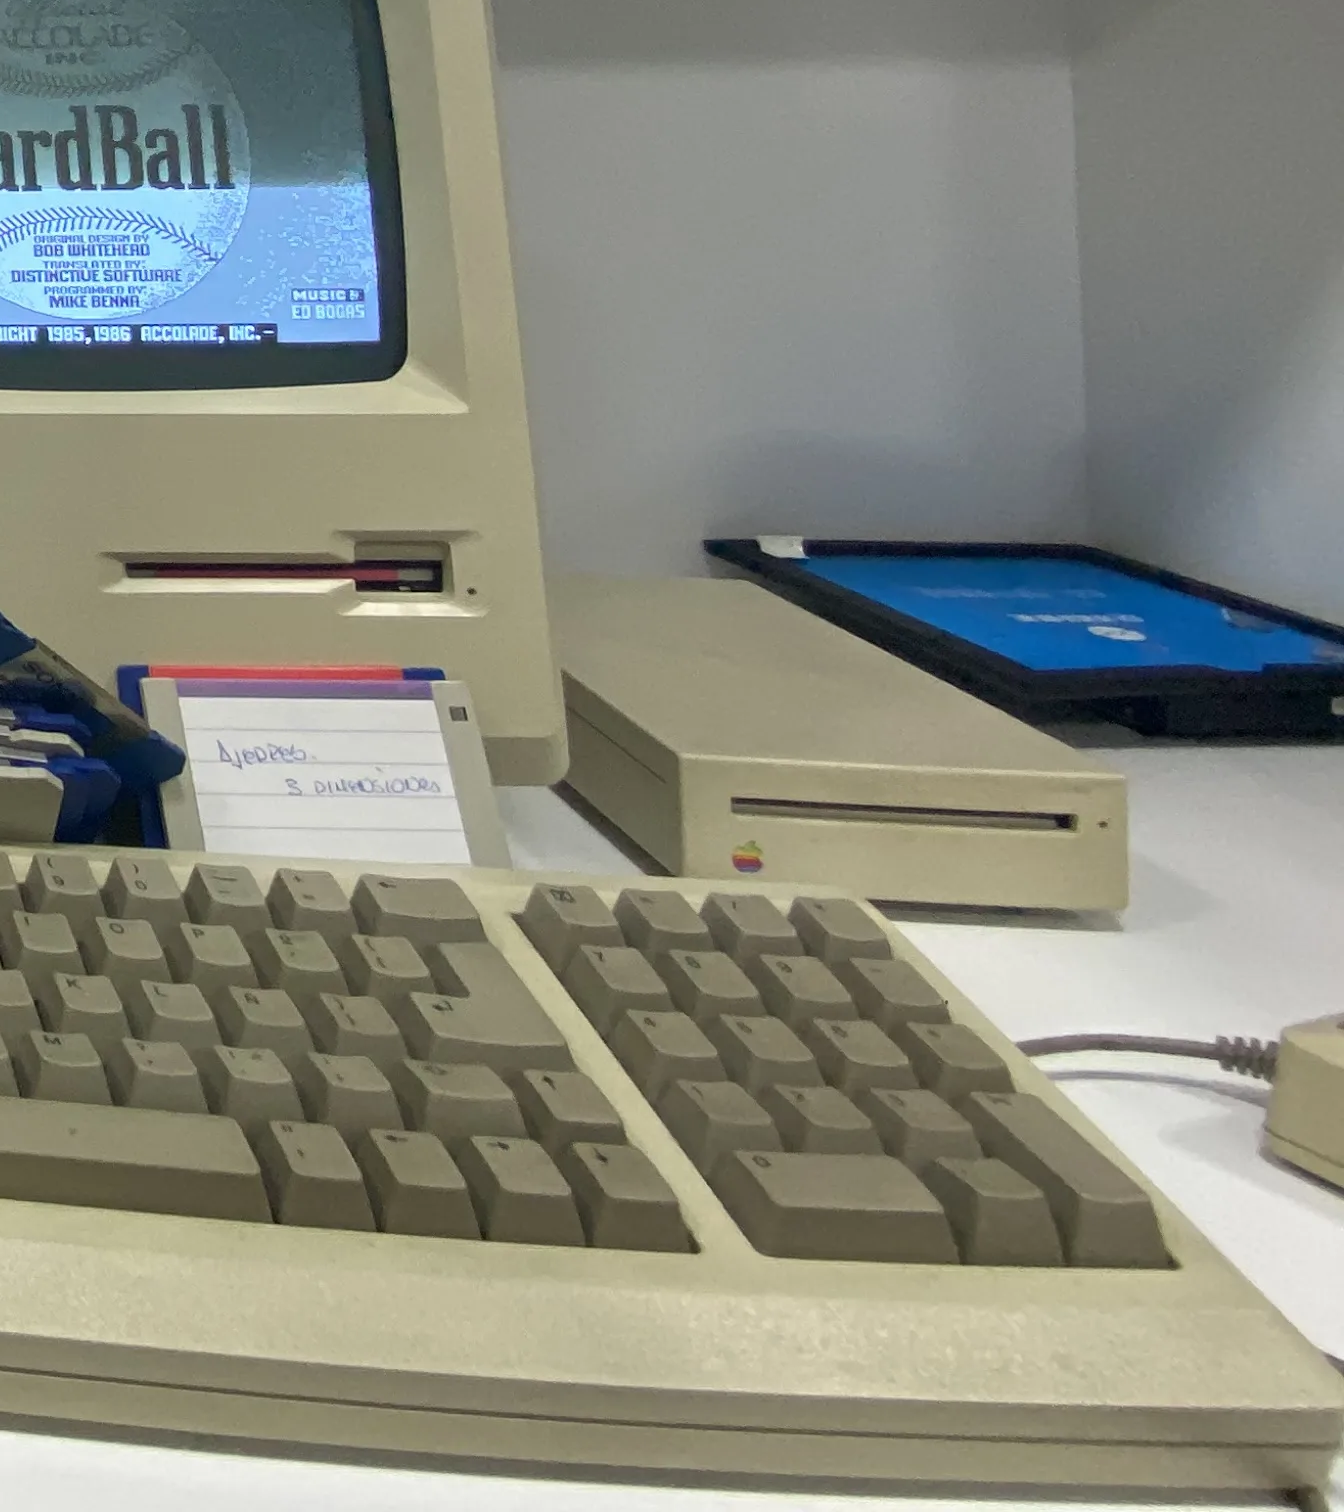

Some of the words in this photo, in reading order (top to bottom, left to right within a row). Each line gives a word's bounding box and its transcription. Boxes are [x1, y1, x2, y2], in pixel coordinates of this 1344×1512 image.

[33, 243, 64, 257] BOB
[67, 243, 151, 257] WHITEHEAD
[43, 260, 123, 269] TRANSLATED
[11, 270, 99, 283] DISTINCTIVE
[103, 269, 182, 283] SOFTWARE
[44, 285, 125, 295] PROGRAMMED
[292, 290, 347, 302] MUSIC
[49, 295, 88, 309] MIKE
[91, 295, 140, 308] BENNA
[291, 304, 312, 320] ED
[315, 303, 365, 320] BOGAS
[46, 325, 132, 345] 1985,1986
[140, 324, 225, 344] ACCOLADE,
[284, 778, 303, 796] 3
[109, 922, 125, 934] O
[191, 928, 205, 938] P
[43, 1033, 62, 1046] M
